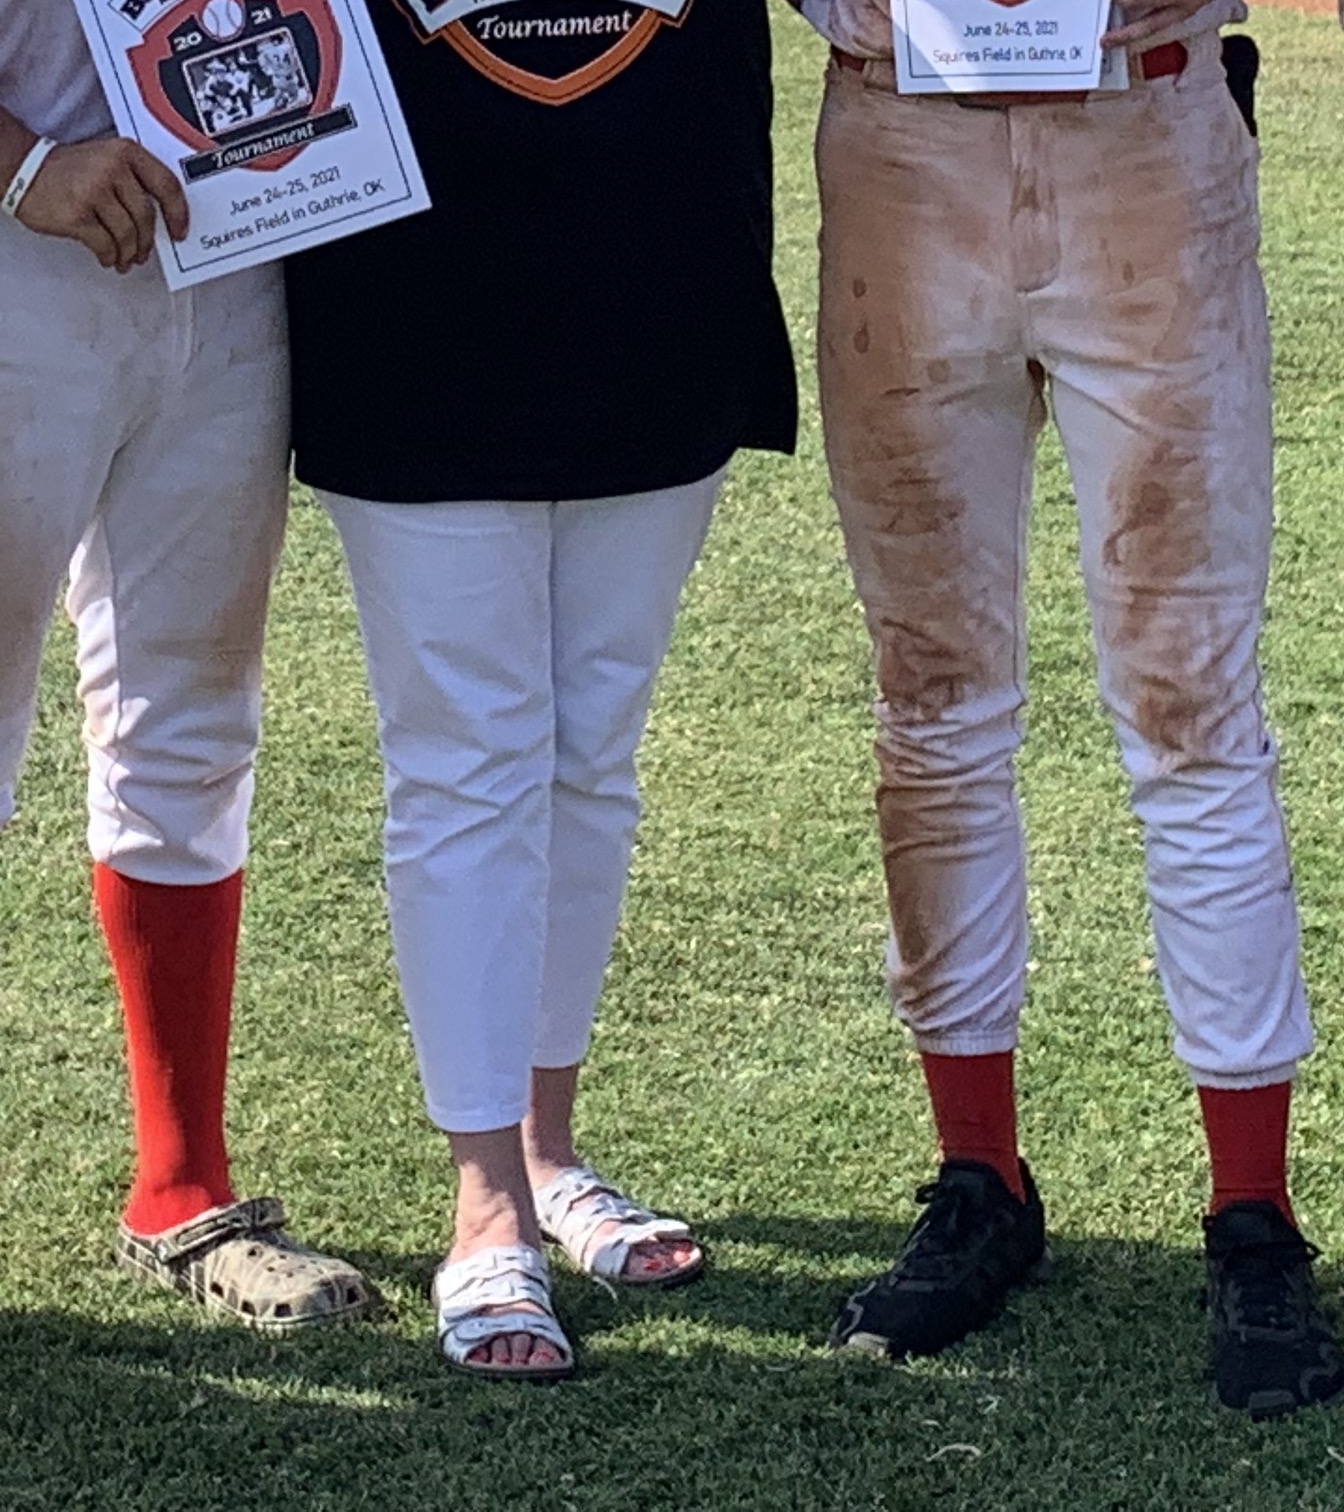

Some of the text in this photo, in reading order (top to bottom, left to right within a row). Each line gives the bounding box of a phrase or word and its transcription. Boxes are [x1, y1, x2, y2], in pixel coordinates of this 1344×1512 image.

[174, 6, 273, 51] 20 21
[476, 10, 635, 40] Tournament
[963, 23, 992, 37] June
[982, 47, 1011, 62] Field
[1013, 45, 1026, 60] in
[1069, 45, 1084, 60] OK
[212, 122, 316, 171] Tournament
[229, 165, 342, 216] June 24-25, 2021
[199, 225, 254, 251] Squires
[255, 209, 291, 233] Field
[292, 206, 306, 221] in
[363, 178, 386, 197] OK
